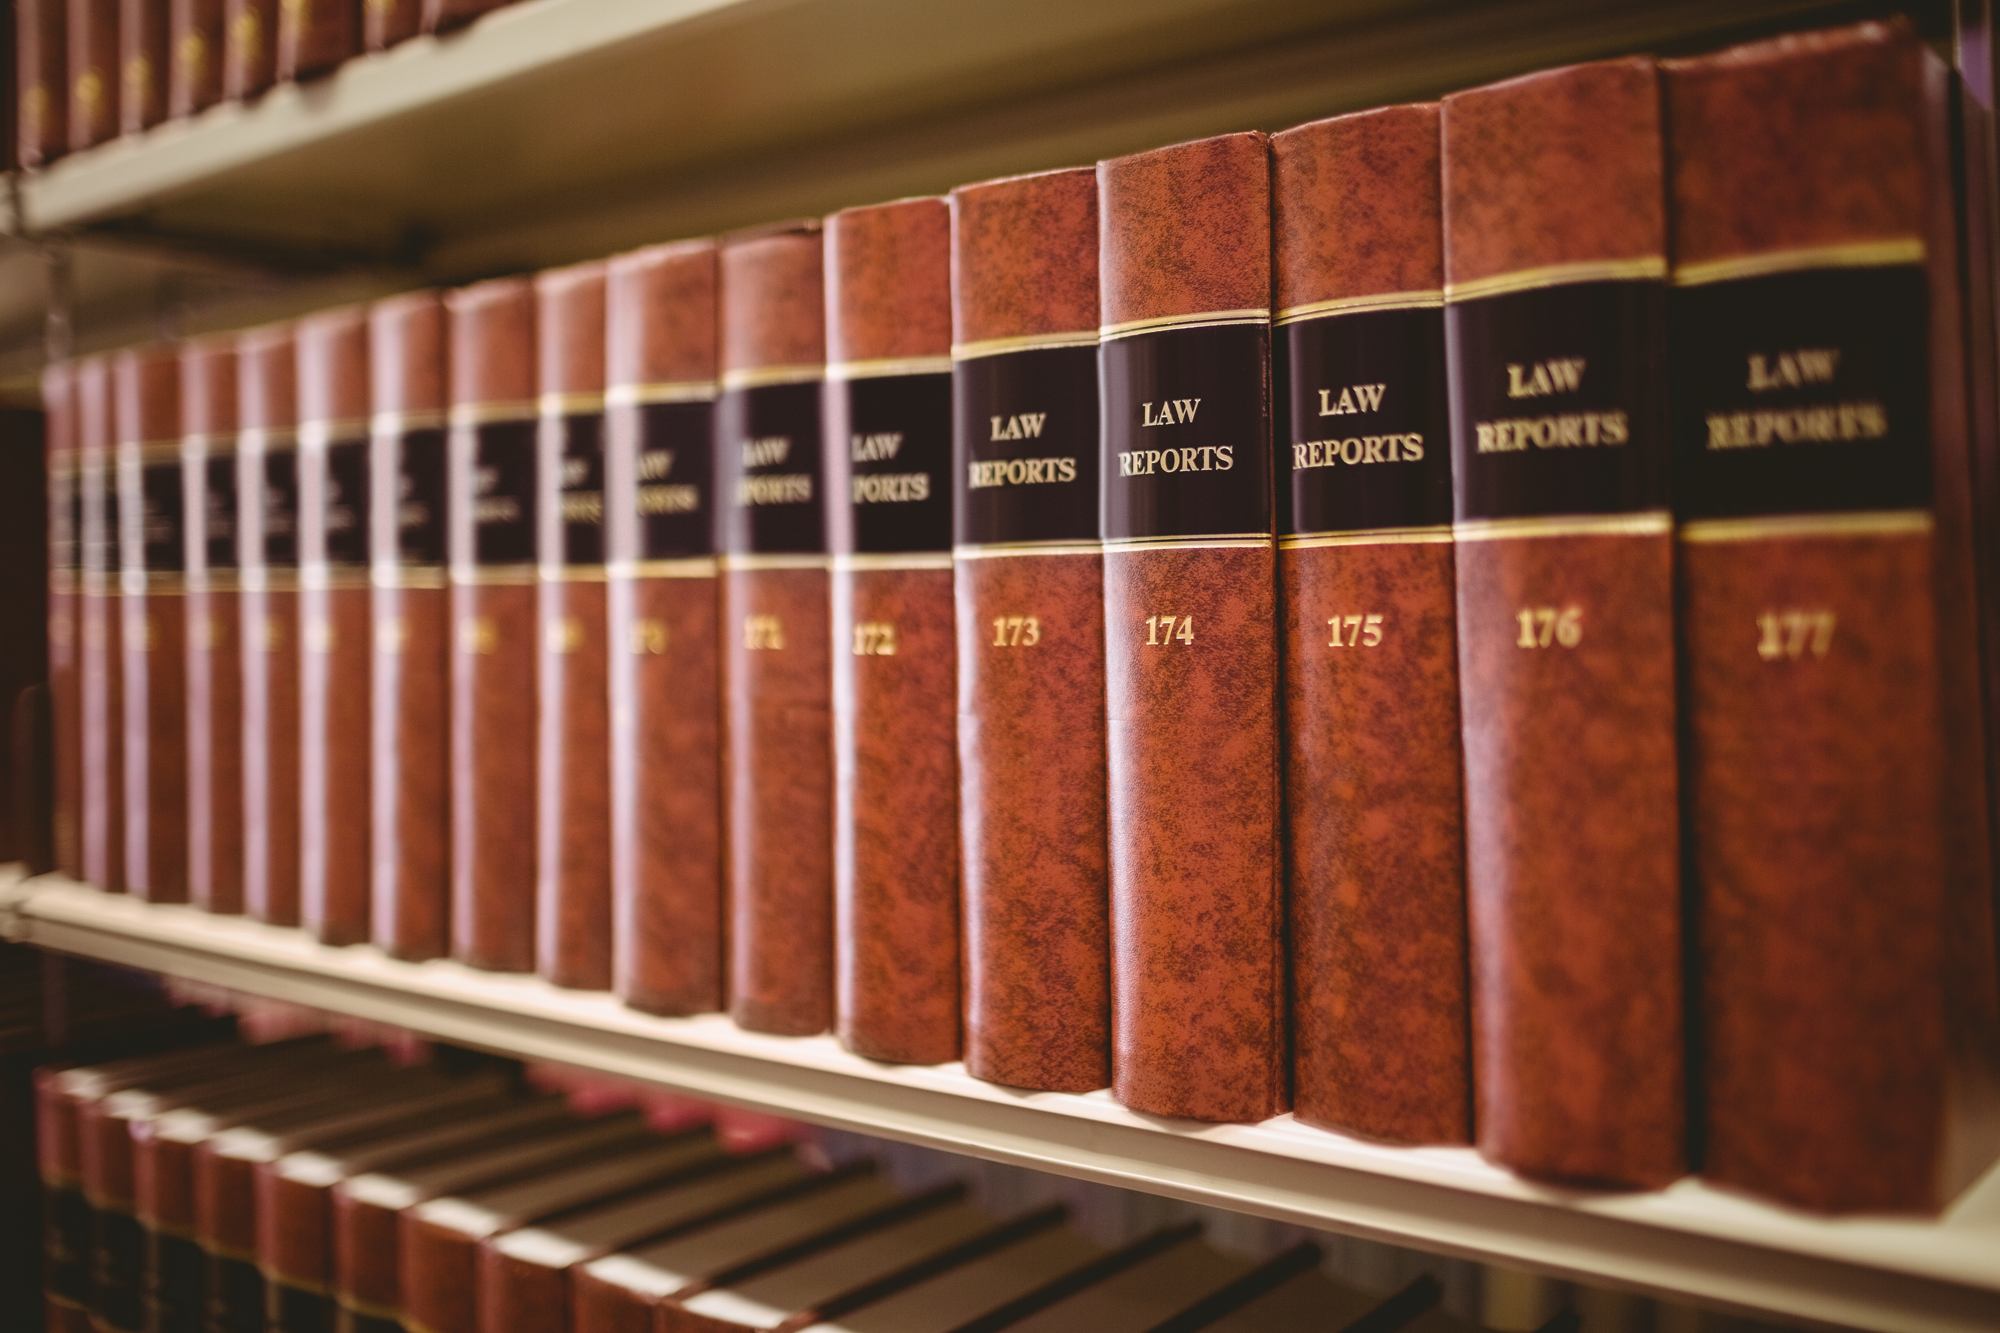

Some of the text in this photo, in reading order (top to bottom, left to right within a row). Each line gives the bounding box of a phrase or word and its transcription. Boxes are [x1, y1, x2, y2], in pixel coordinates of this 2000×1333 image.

[1507, 359, 1586, 399] LAW
[1747, 349, 1840, 390] LAW
[1142, 399, 1201, 427] LAW
[1318, 384, 1386, 417] LAW
[991, 413, 1046, 441] LAW
[1476, 411, 1629, 454] REPORTS
[1706, 402, 1887, 451] REPORTS
[1118, 446, 1234, 477] REPORTS
[1292, 433, 1424, 470] REPORTS
[852, 474, 930, 504] PORTS
[968, 457, 1077, 490] REPORTS
[853, 622, 897, 656] 172
[992, 617, 1042, 647] 173
[1145, 615, 1194, 646] 174
[1327, 614, 1384, 648] 175
[1515, 607, 1584, 650] 176
[1757, 610, 1836, 661] 177
